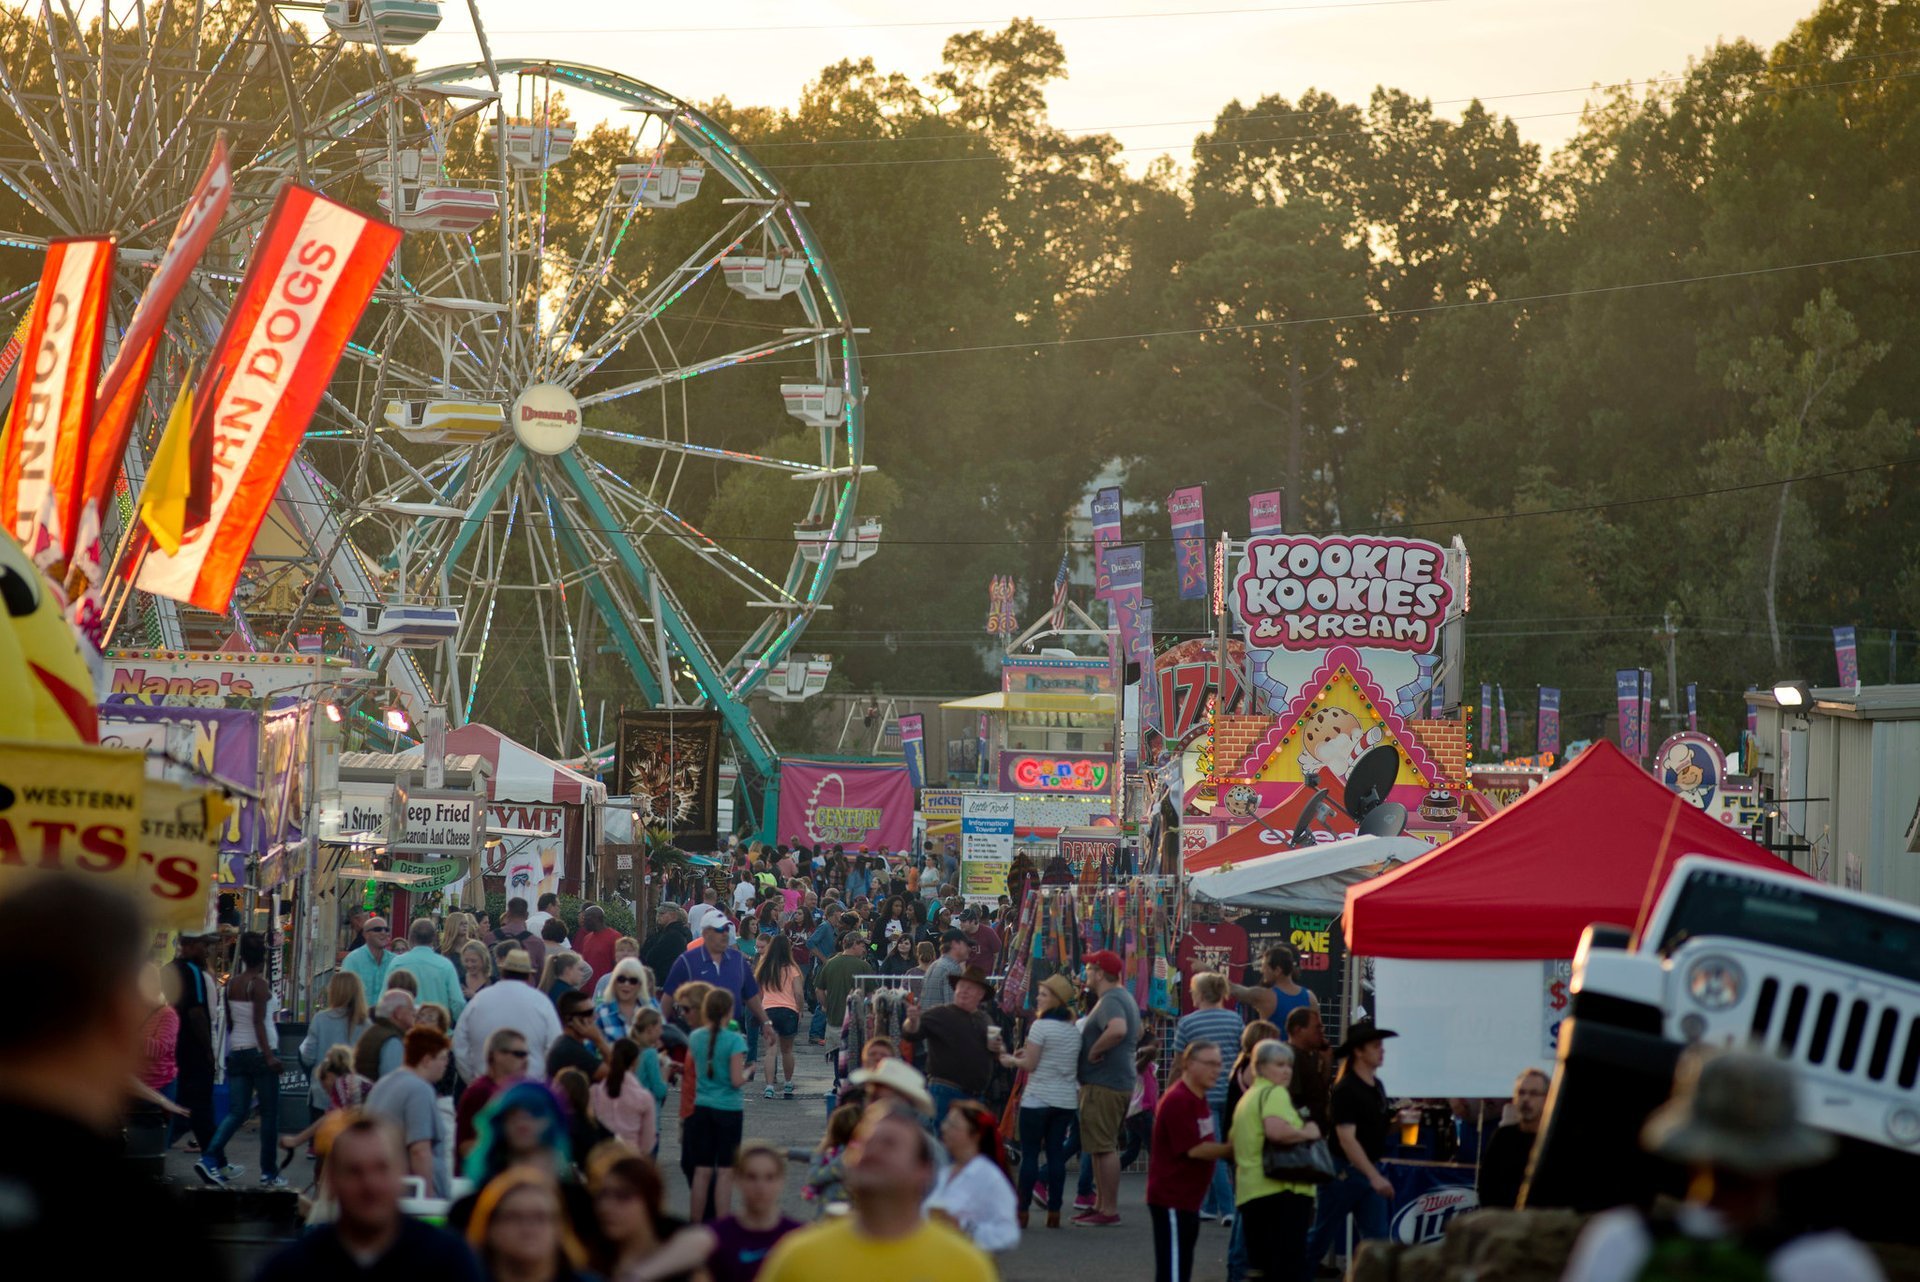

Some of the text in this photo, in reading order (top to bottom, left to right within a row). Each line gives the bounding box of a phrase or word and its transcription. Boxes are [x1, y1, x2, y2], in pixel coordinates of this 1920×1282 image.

[246, 238, 337, 385] DOGS
[20, 292, 69, 480] CORN
[1254, 544, 1436, 583] KOOKIE
[1244, 577, 1444, 616] KOOKIES
[1255, 618, 1282, 638] &
[112, 668, 254, 698] Nana's
[1015, 759, 1107, 788] Candy
[22, 786, 133, 811] WESTERN
[989, 801, 1009, 814] Rock
[407, 803, 471, 826] eep Fried
[487, 805, 562, 838] YME
[816, 807, 882, 829] CENTURY
[968, 819, 1009, 827] Information
[140, 818, 204, 842] STERN
[429, 828, 445, 845] And
[446, 828, 471, 846] Cheese
[400, 862, 452, 877] DEEP FRIED
[1290, 930, 1331, 953] ONE
[1419, 1195, 1465, 1213] Miller
